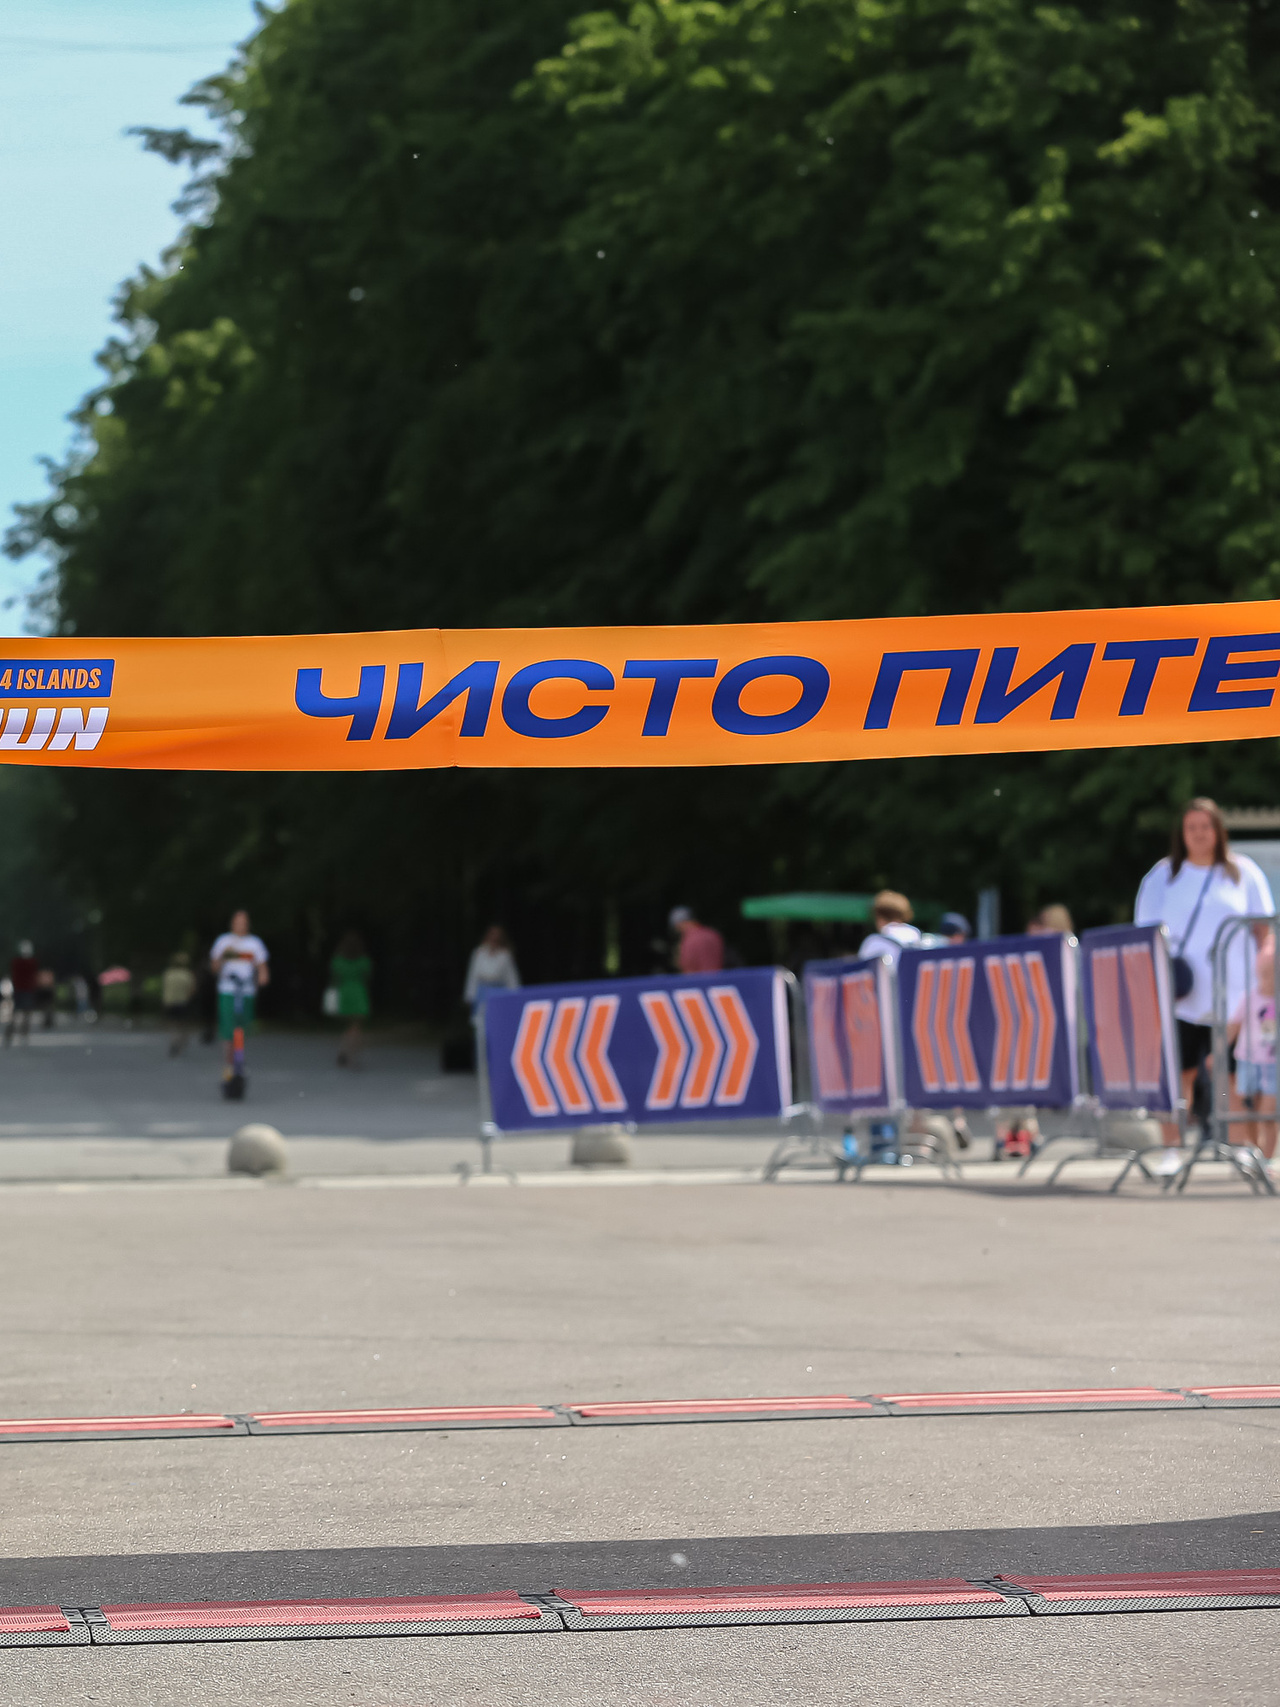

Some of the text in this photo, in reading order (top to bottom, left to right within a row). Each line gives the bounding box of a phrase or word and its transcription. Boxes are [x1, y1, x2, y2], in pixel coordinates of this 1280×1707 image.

[0, 668, 102, 690] 4 ISLANDS
[294, 656, 831, 741] ЧИСТО
